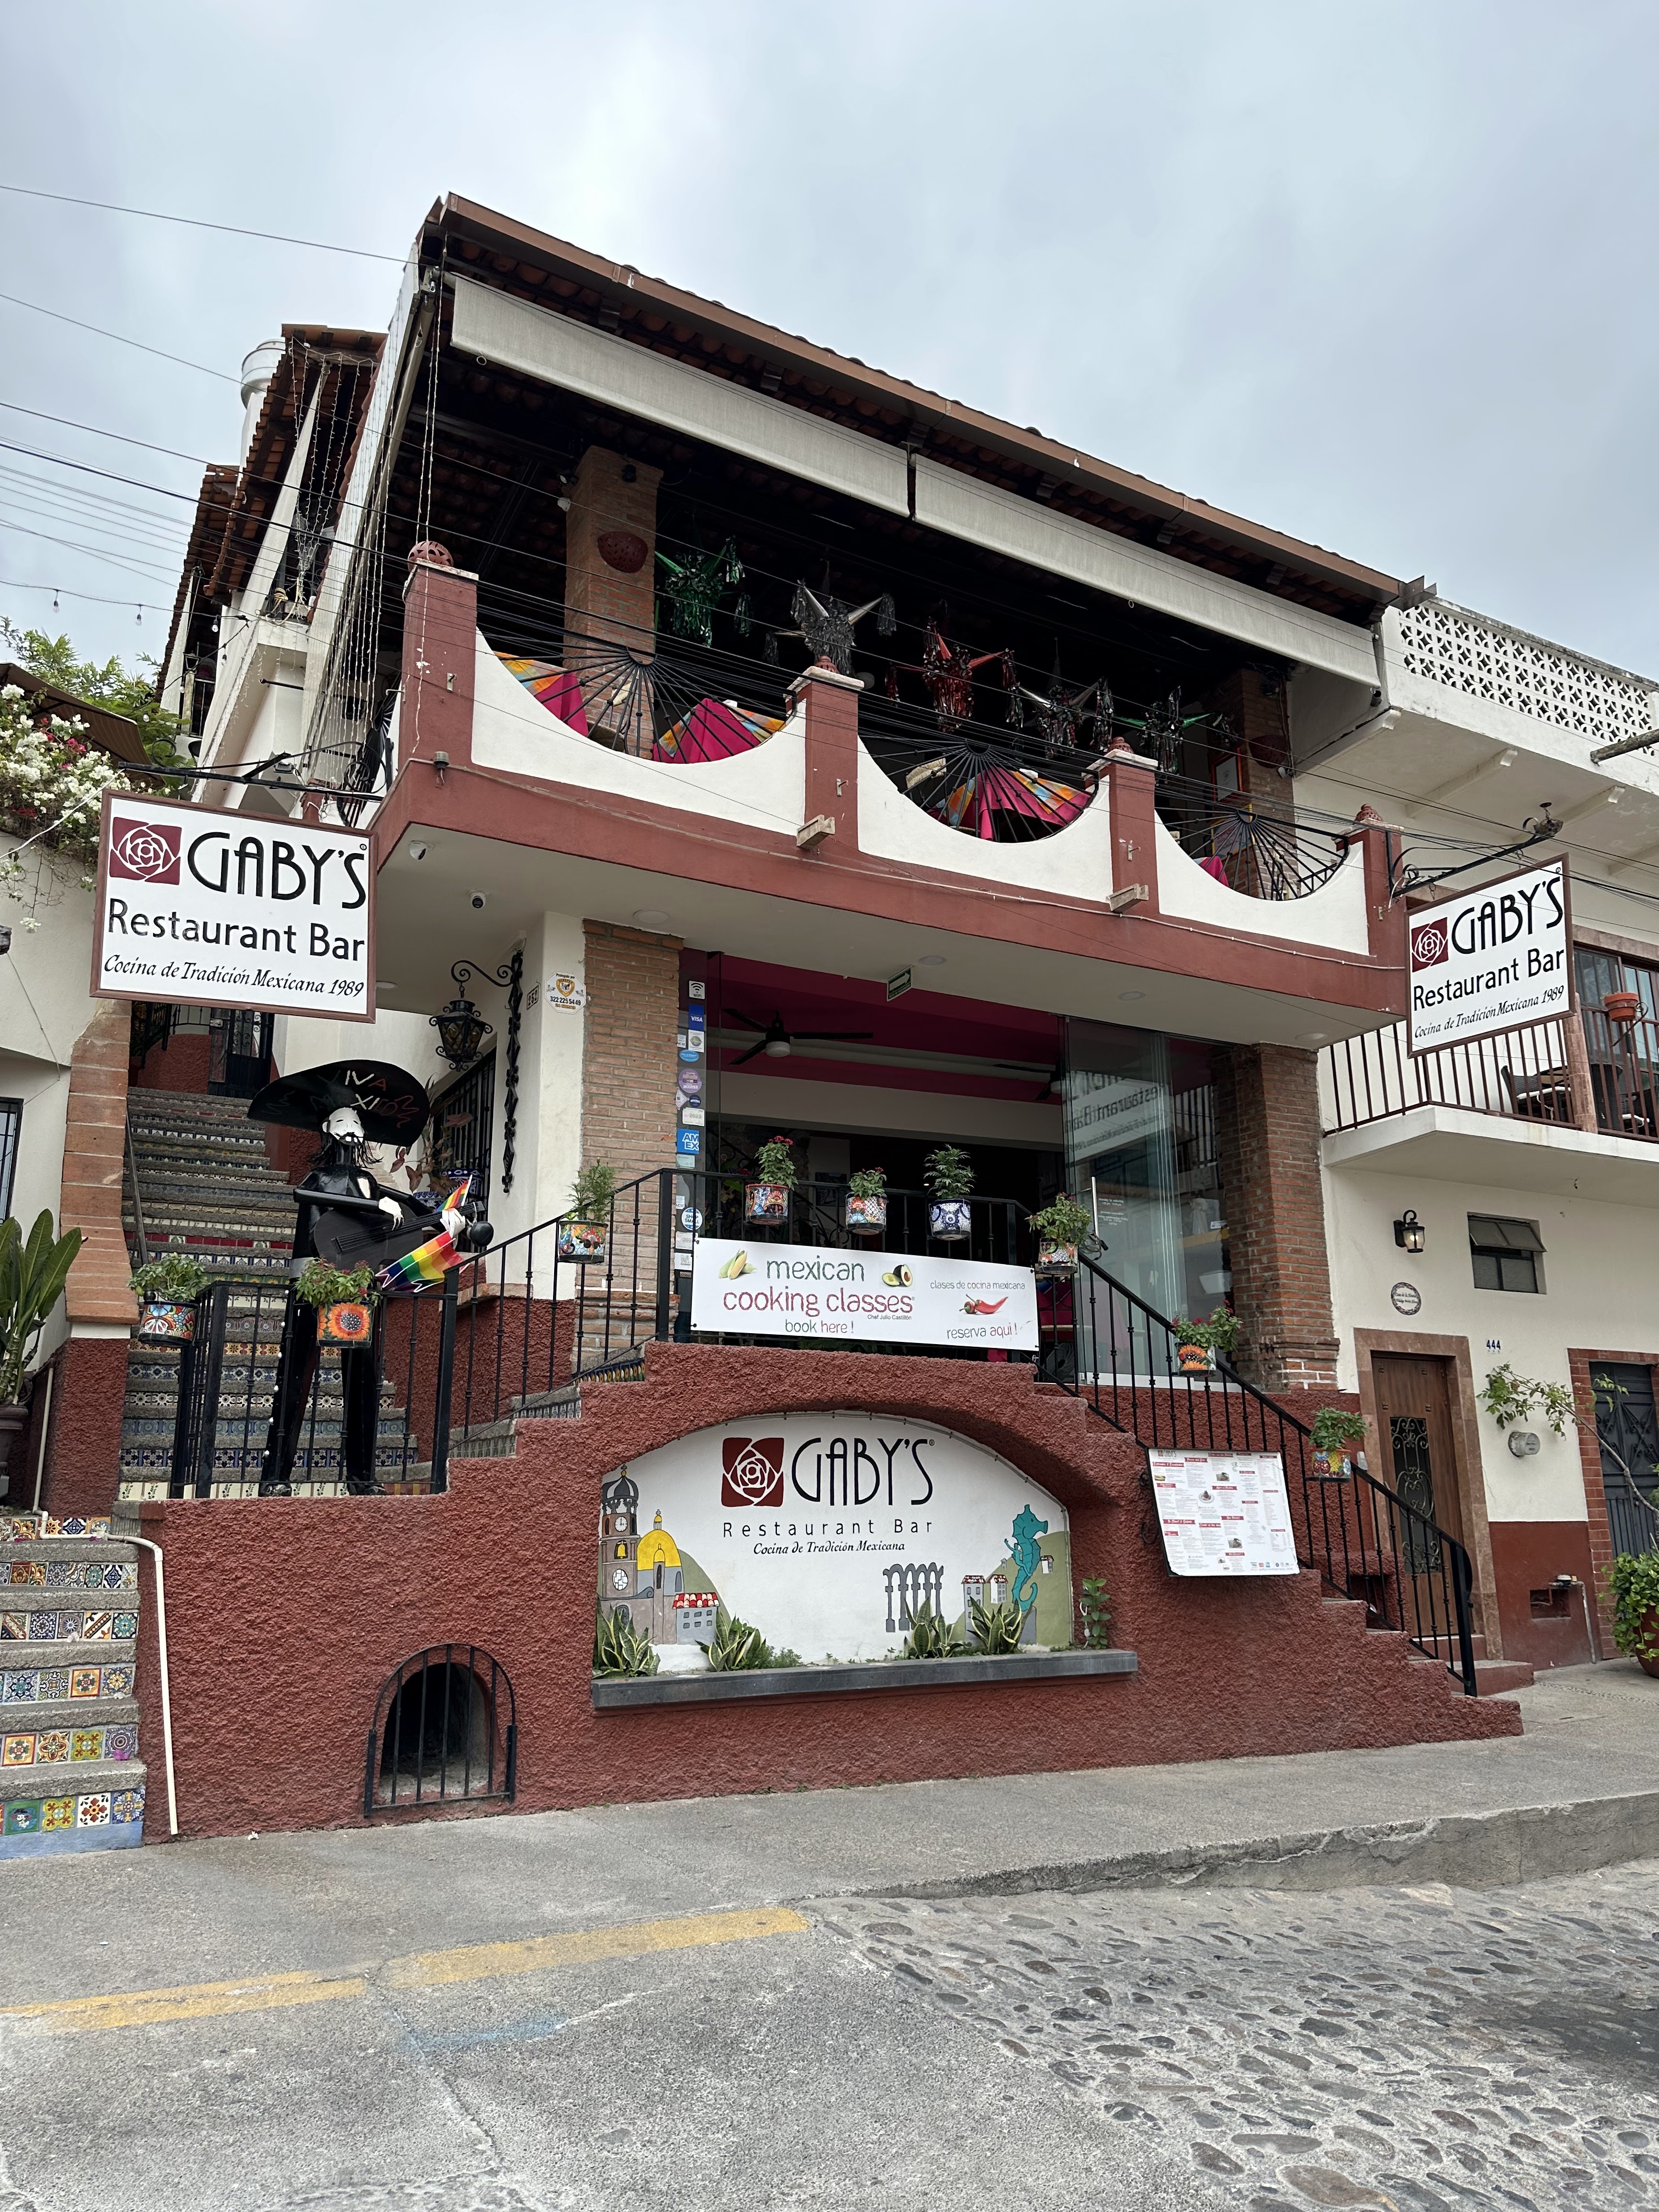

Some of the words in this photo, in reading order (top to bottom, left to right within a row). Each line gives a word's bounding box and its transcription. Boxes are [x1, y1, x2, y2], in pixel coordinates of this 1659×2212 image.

[187, 831, 367, 909] GABY'S
[1451, 876, 1563, 954] GABY'S
[108, 898, 297, 953] Restaurant
[309, 923, 365, 961] Bar
[104, 954, 156, 976] Cocina
[161, 961, 178, 978] de
[180, 961, 250, 985] Tradición
[251, 969, 325, 994] Mexicana
[328, 979, 364, 997] 1989
[1414, 957, 1519, 1011] Restaurant
[1527, 948, 1564, 978] Bar
[1414, 1023, 1441, 1038] Cocina
[1444, 1017, 1455, 1030] de
[1455, 1006, 1497, 1028] Tradición
[1497, 996, 1539, 1014] Mexicana
[1541, 985, 1564, 1004] 1989
[682, 1133, 699, 1142] AM
[685, 1142, 699, 1150] EX
[766, 1255, 865, 1282] mexican
[930, 1280, 955, 1289] clases
[956, 1280, 966, 1289] de
[967, 1280, 991, 1289] cocina
[992, 1281, 1025, 1290] mexicana
[723, 1285, 821, 1317] cooking
[826, 1287, 913, 1313] classes
[785, 1319, 817, 1333] book
[821, 1320, 848, 1333] here
[946, 1327, 986, 1339] reserva
[1486, 1339, 1501, 1350] 444
[791, 1437, 933, 1506] GABY'S
[723, 1519, 874, 1538] Restaurant
[894, 1519, 932, 1533] Bar
[753, 1542, 788, 1555] Cocina
[792, 1541, 803, 1553] de
[807, 1541, 854, 1553] Tradición
[856, 1540, 905, 1551] Mexicana
